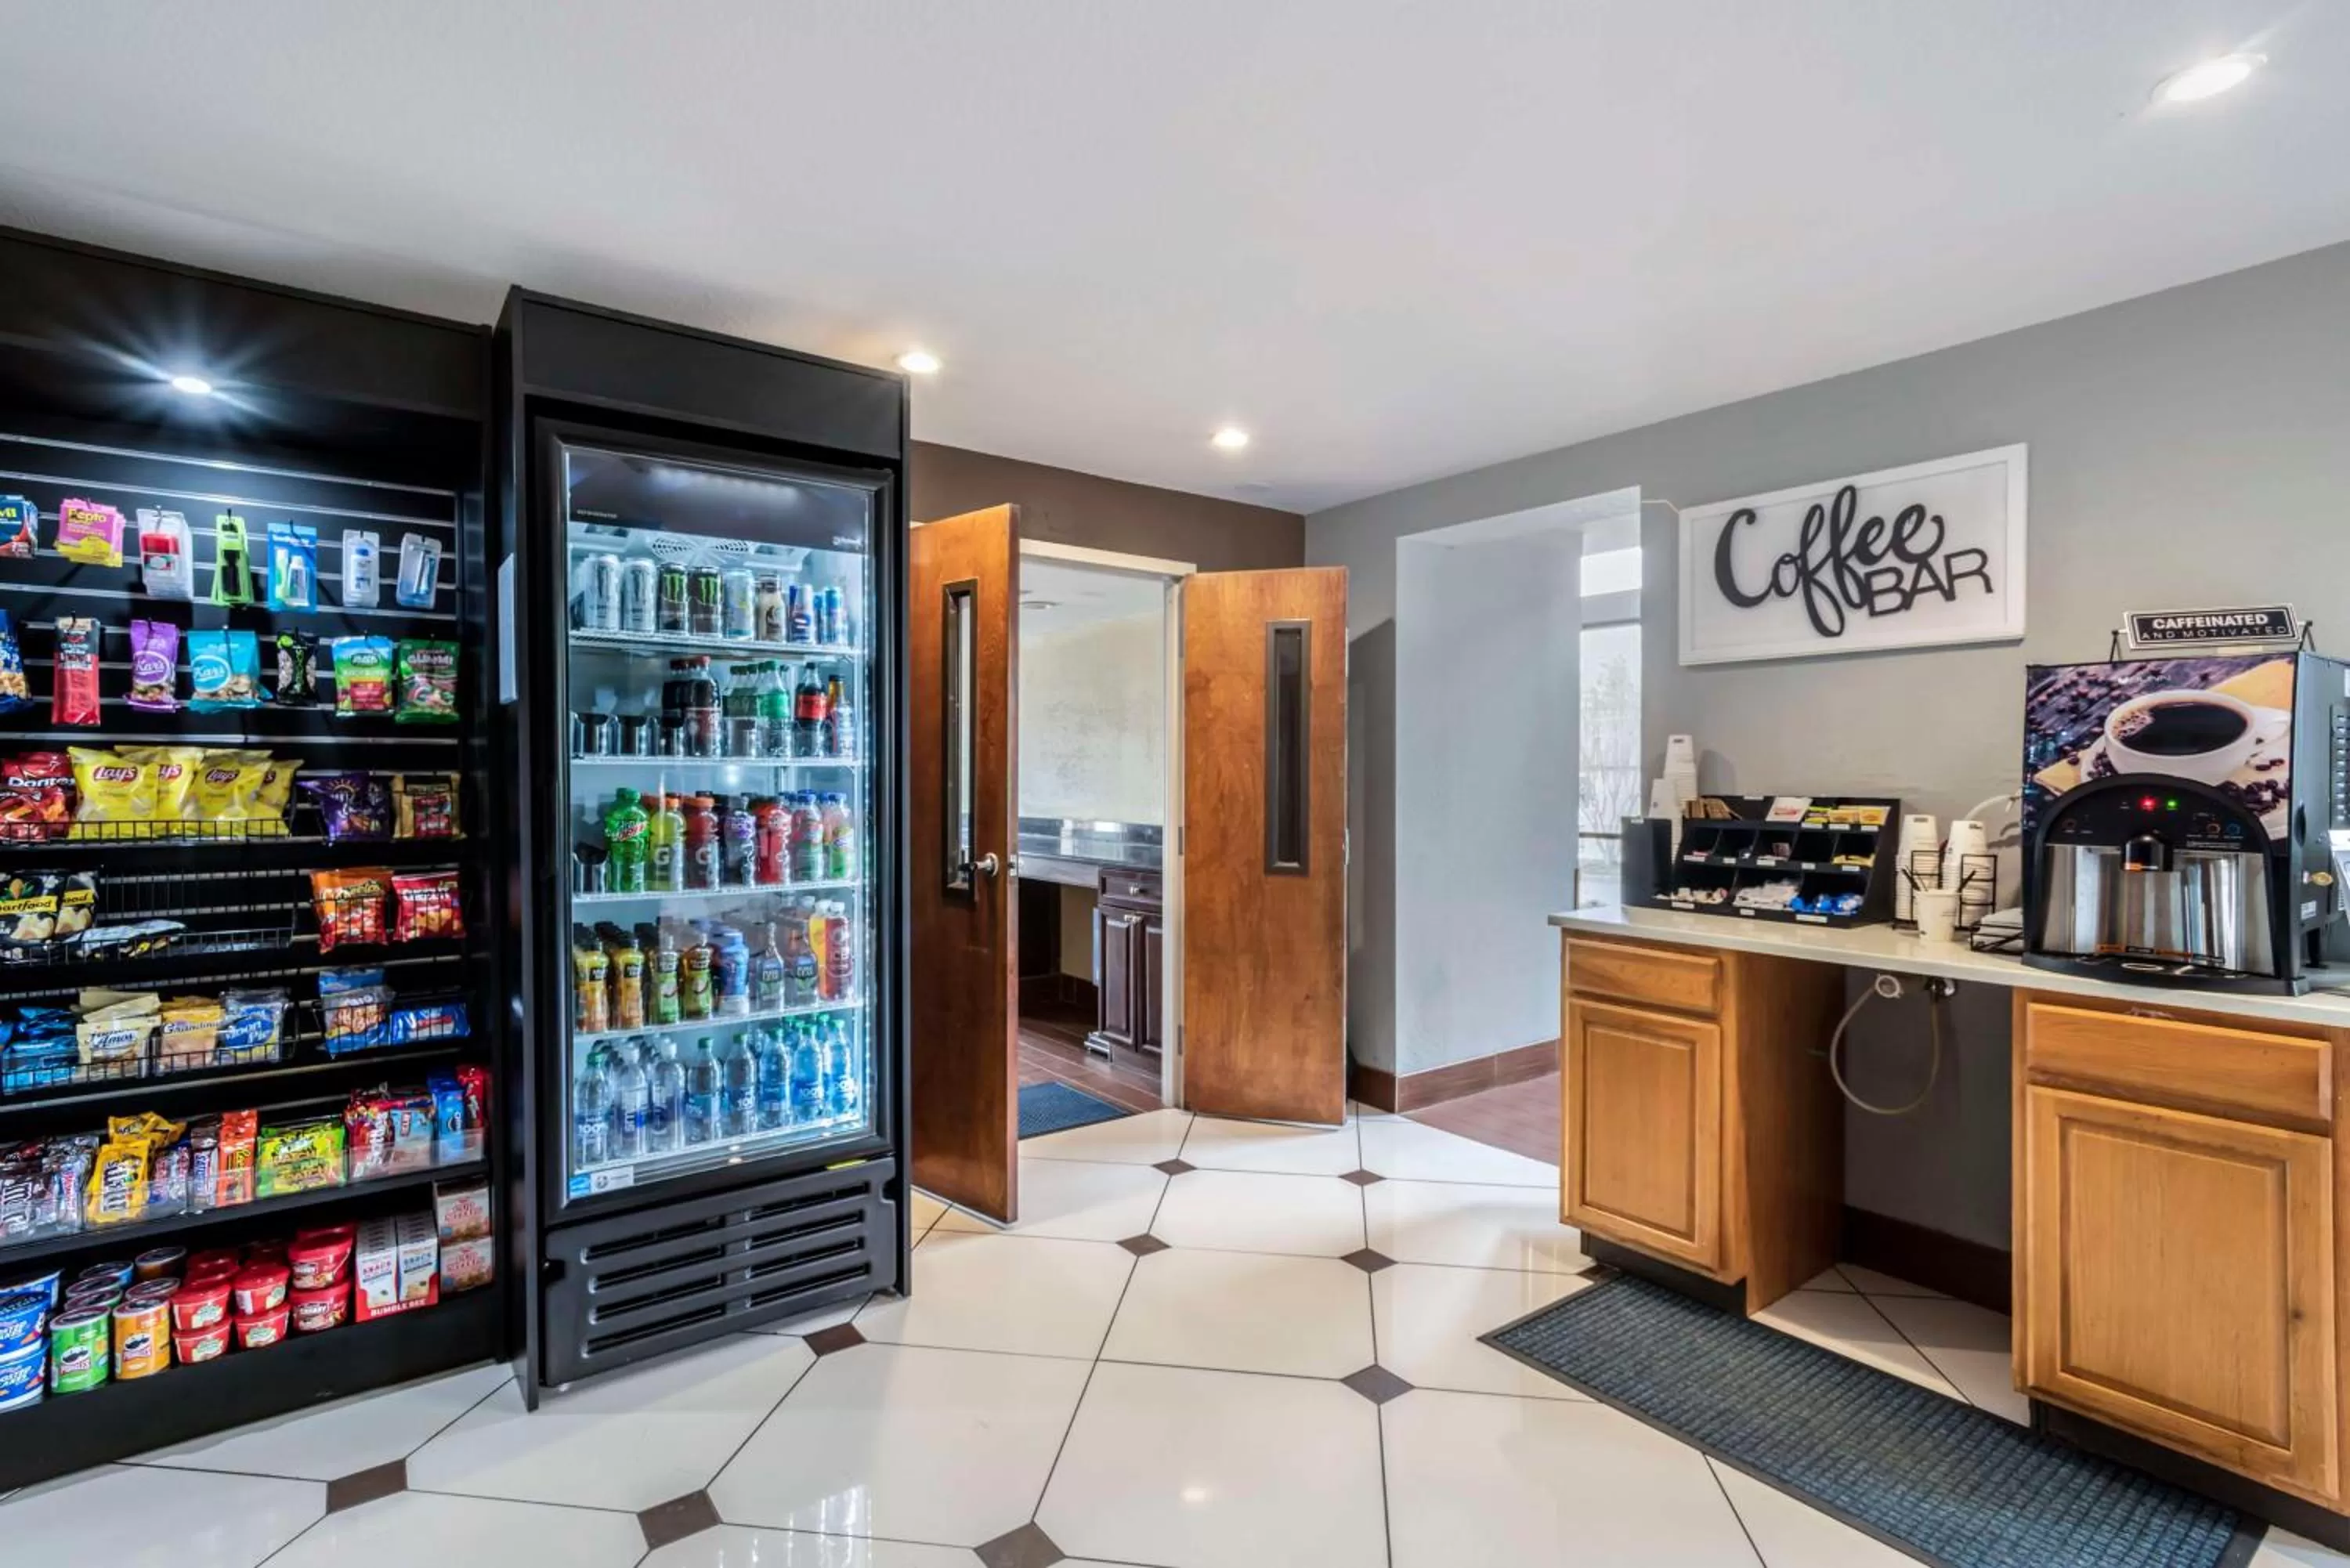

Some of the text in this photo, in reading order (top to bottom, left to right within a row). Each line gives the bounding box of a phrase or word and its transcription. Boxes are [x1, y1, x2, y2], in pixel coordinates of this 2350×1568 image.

[1714, 485, 1946, 637] Coffee
[1864, 547, 1994, 617] BAR
[2153, 613, 2269, 630] CAFFEINATED
[2142, 626, 2287, 640] AND MOTIVATED
[8, 776, 76, 787] Doritos
[654, 846, 671, 865] G
